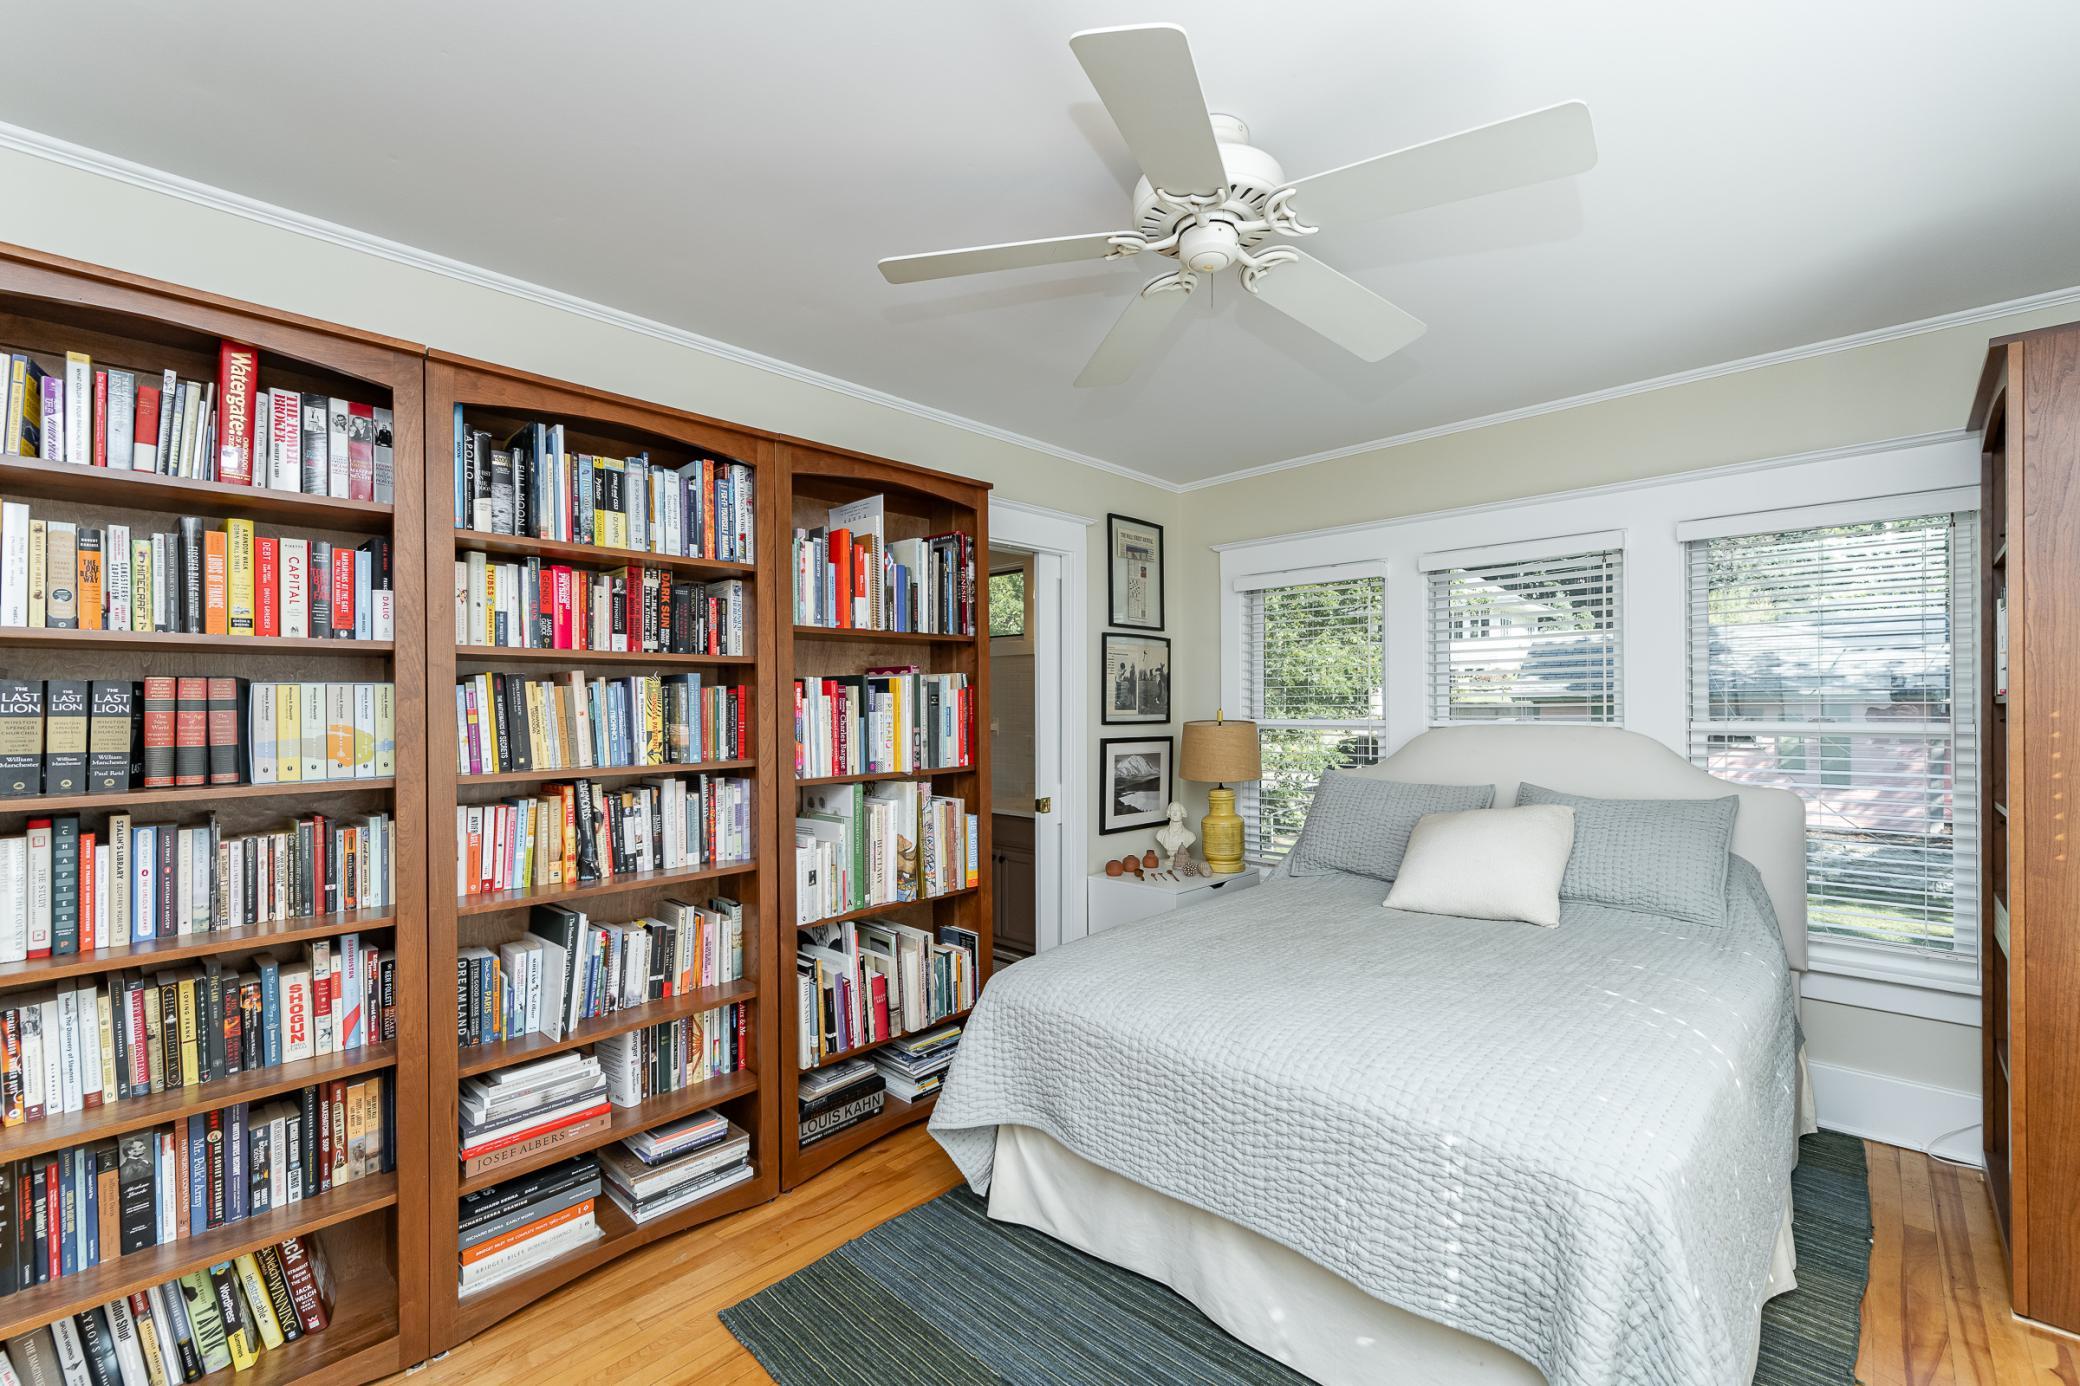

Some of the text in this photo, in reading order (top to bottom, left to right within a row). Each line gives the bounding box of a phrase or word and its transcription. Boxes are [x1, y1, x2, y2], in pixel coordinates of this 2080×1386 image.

[226, 352, 252, 435] Watergate:
[274, 393, 286, 443] BROKER
[286, 395, 299, 465] THE POWER
[465, 435, 474, 480] APOLLO
[517, 464, 526, 527] FULL MOON
[262, 542, 271, 560] DEBT
[111, 563, 120, 600] CAPITALISM
[120, 562, 129, 599] GANGSTERS
[208, 554, 224, 609] LORDS OF FINANCE
[288, 556, 300, 605] CAPITAL
[341, 552, 349, 582] BARBARIANS
[487, 569, 495, 596] TUBES
[136, 564, 146, 620] MINECRAFT
[341, 590, 349, 600] THE
[542, 575, 550, 605] GENIUS
[558, 573, 567, 604] PHYSICS
[661, 572, 671, 628] DARK SUN
[263, 587, 271, 629] DAVID GRAEBER
[341, 600, 349, 613] GATE
[382, 596, 390, 620] DALIO
[0, 703, 41, 713] LION
[2, 692, 41, 703] LAST
[52, 703, 82, 711] LION
[53, 695, 83, 703] LAST
[93, 703, 130, 713] LION
[95, 693, 130, 703] LAST
[497, 703, 505, 730] MATHEMATICS
[499, 736, 509, 759] SECRETS
[651, 721, 659, 750] PATTERNS
[839, 714, 848, 769] Charles Bargue
[579, 783, 591, 820] DIAMONDS
[116, 820, 124, 850] STALIN'S
[968, 820, 978, 867] de Kooning
[61, 830, 69, 922] CHAPTER
[116, 851, 124, 880] LIBRARY
[38, 868, 47, 909] THE STUDY
[384, 970, 392, 1006] KEN FOLLETT
[457, 961, 467, 1036] DREAMLAND
[483, 991, 492, 1014] PARIS
[802, 981, 810, 1003] JOHN
[133, 997, 142, 1016] VERY
[289, 983, 305, 1044] SHOGUN
[65, 1027, 73, 1052] Discovery
[133, 1016, 144, 1041] PRIVATE
[6, 1010, 19, 1095] MICHAEL CHABON WONDER BOYS
[135, 1042, 146, 1083] GENTLEMAN
[800, 1108, 841, 1136] LOUIS
[844, 1093, 882, 1119] KAHN
[232, 1122, 240, 1176] UNITED STATES HISTORY
[253, 1148, 261, 1171] IDENTITY
[258, 1140, 266, 1163] BOURNE
[476, 1148, 518, 1172] JOSEF
[519, 1131, 566, 1155] ALBERS
[188, 1138, 205, 1208] Mr. Polk's Army
[214, 1142, 223, 1220] THE SOVIET EXPERIMENT
[290, 1170, 300, 1189] CONGO
[474, 1193, 519, 1214] RICHARD SERRA
[483, 1210, 501, 1220] SERRA
[503, 1199, 528, 1212] DRAWING
[465, 1229, 488, 1243] RICHARD
[506, 1217, 521, 1226] EARLY
[520, 1212, 535, 1220] WORK
[475, 1245, 494, 1257] BRIDGET
[514, 1227, 535, 1241] COMPLETE
[535, 1223, 548, 1231] PRINTS
[281, 1239, 305, 1265] ack
[475, 1258, 505, 1274] BRIDGET
[507, 1249, 525, 1260] RILEY
[218, 1282, 236, 1324] WordPress
[244, 1273, 268, 1320] indistractable
[262, 1253, 297, 1332] Welch WINNING
[194, 1301, 227, 1355] TANK
[23, 1339, 36, 1354] THE
